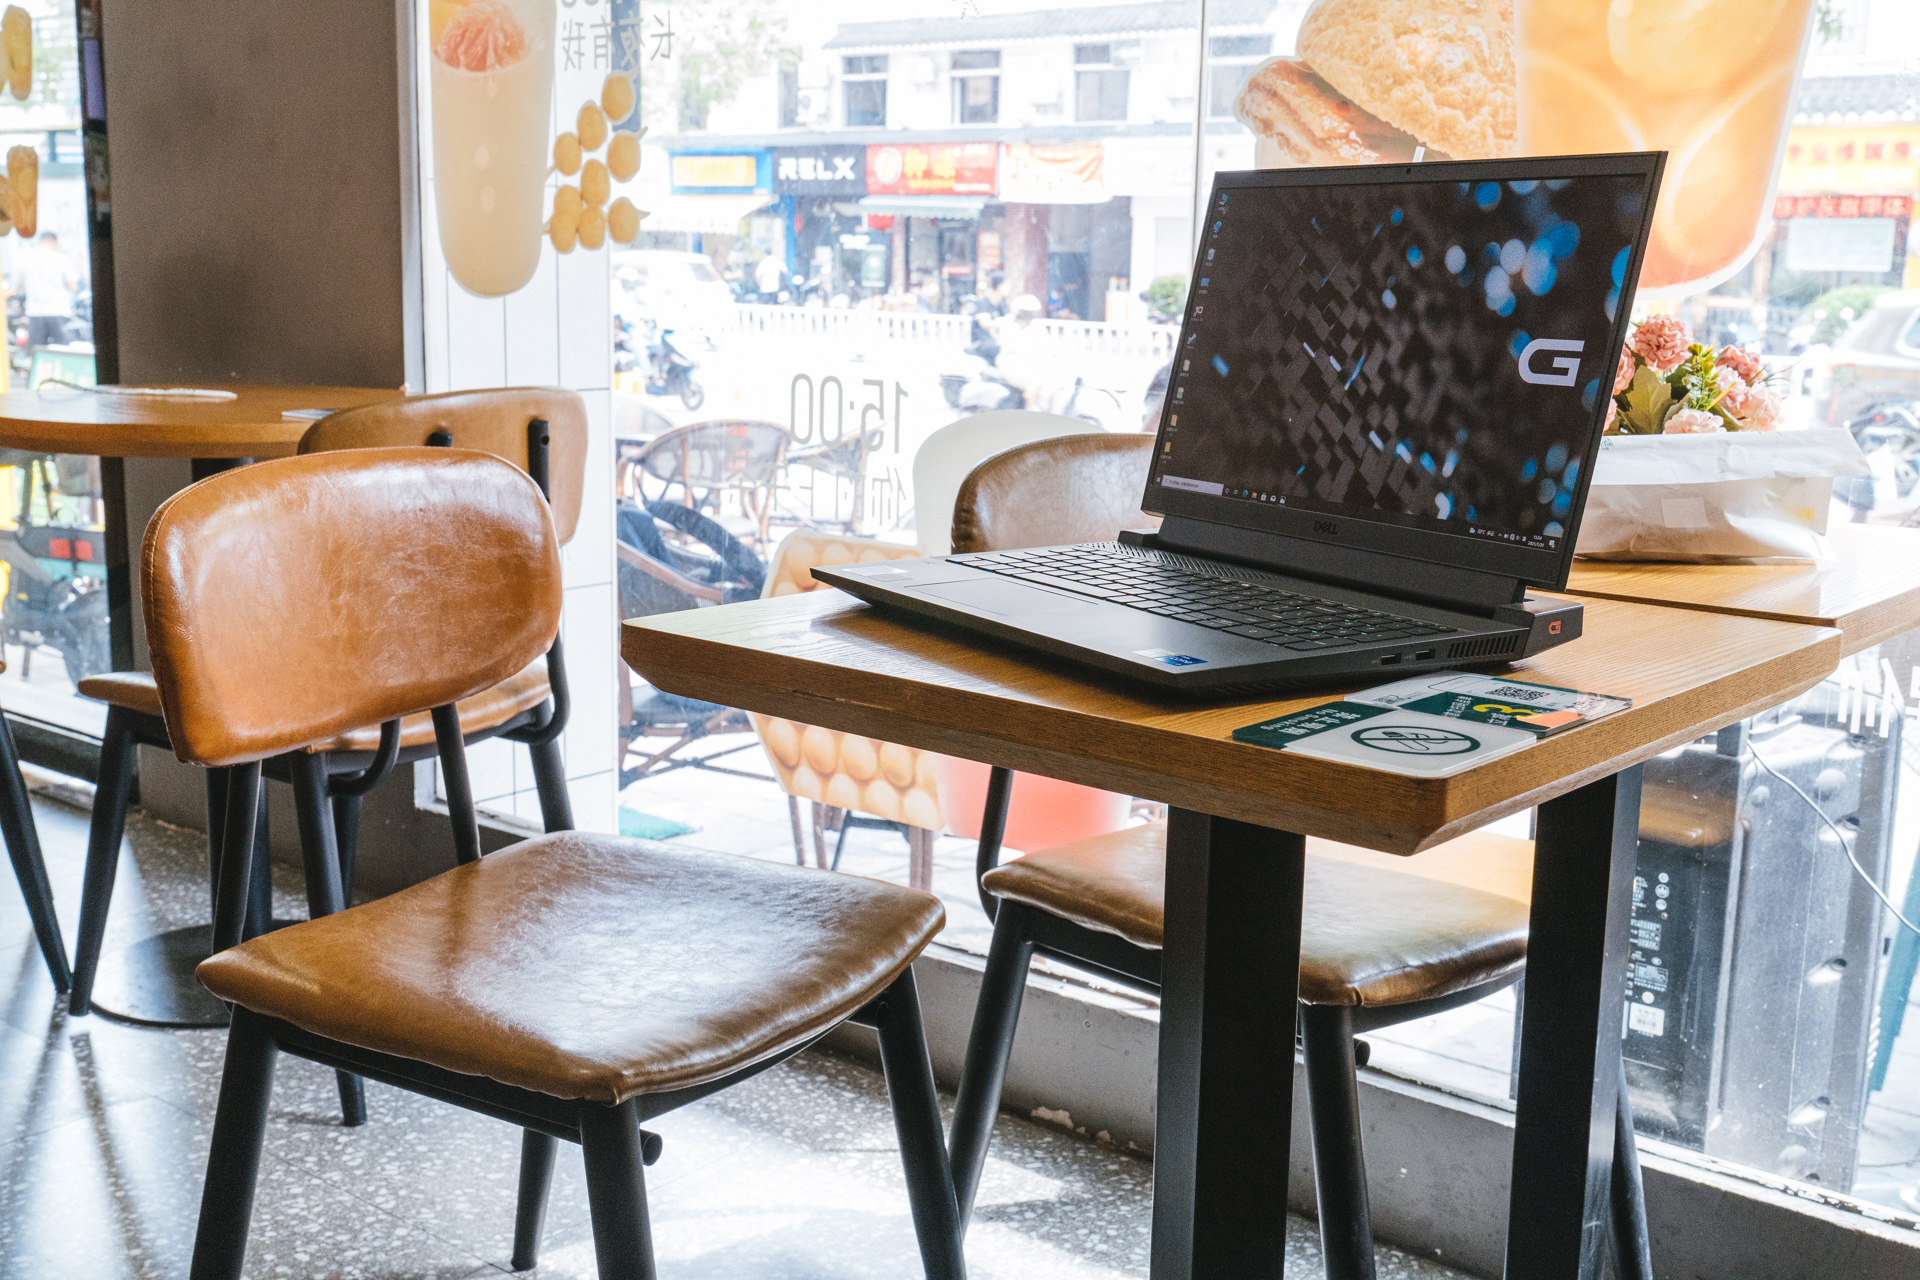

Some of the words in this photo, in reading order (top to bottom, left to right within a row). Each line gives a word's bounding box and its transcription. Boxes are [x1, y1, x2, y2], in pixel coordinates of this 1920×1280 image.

[778, 156, 856, 181] RELX
[1518, 338, 1585, 387] G
[1313, 520, 1338, 535] DELL
[1548, 619, 1562, 635] G
[1473, 704, 1543, 718] 3
[1260, 713, 1319, 730] Smoking
[1278, 711, 1361, 735] 禁止吸烟
